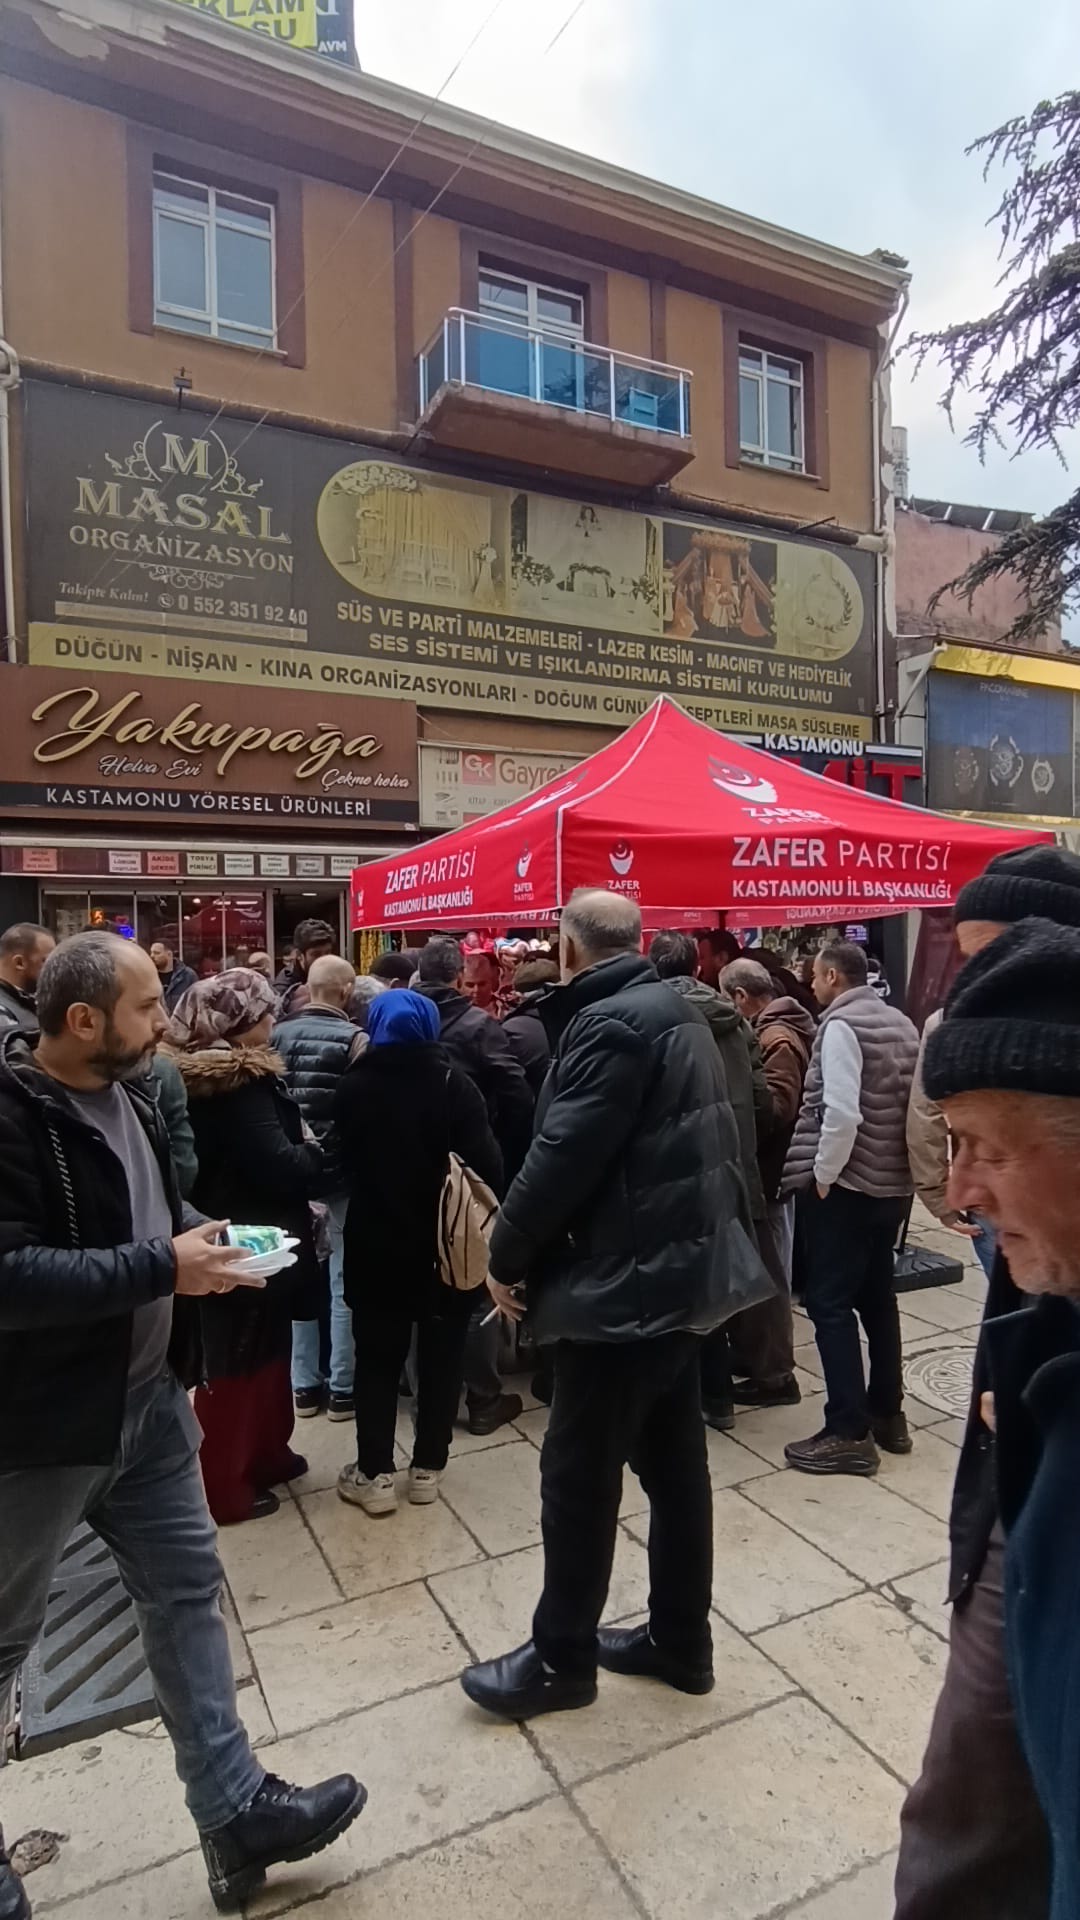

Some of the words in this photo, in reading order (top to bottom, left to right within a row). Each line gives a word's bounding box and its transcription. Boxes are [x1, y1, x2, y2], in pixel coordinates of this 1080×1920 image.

[184, 0, 305, 17] KLAM
[318, 40, 347, 53] AVM
[159, 432, 213, 480] M
[73, 476, 292, 544] MASAL
[69, 525, 294, 574] ORGANİZASYON
[59, 582, 105, 602] Takipte
[178, 595, 188, 611] 0
[194, 597, 224, 615] 552
[229, 601, 258, 619] 351
[264, 606, 284, 622] 92
[288, 608, 308, 626] 40
[337, 601, 373, 623] SÜS
[379, 607, 403, 628] VE
[408, 612, 462, 636] PARTİ
[467, 619, 582, 652] MALZEMELERİ
[598, 637, 646, 660] LAZER
[650, 644, 693, 667] KESİM
[707, 652, 763, 675] MAGNET
[768, 661, 785, 678] VE
[789, 664, 852, 688] HEDİYELİK
[369, 632, 409, 653] SES
[415, 636, 498, 665] SİSTEMİ
[506, 651, 531, 668] VE
[538, 654, 671, 685] IŞIKLANDIRMA
[676, 669, 741, 693] SİSTEMİ
[747, 680, 833, 704] KURULUMU
[55, 635, 143, 663] DÜĞÜN
[167, 646, 238, 673] NİŞAN
[260, 658, 314, 680] KINA
[320, 664, 517, 702] ORGANİZASYONLARI
[534, 689, 598, 710] DOĞUM
[603, 695, 648, 715] GÜNÜ
[683, 705, 753, 727] SEPTLERİ
[757, 713, 798, 732] MASA
[801, 716, 860, 738] SÜSLEME
[31, 686, 384, 779] Yakupağa
[764, 732, 864, 757] KASTAMONU
[98, 754, 160, 777] Helva
[164, 758, 203, 778] Evi
[321, 768, 372, 792] Çekme
[464, 753, 494, 779] GK
[46, 787, 181, 809] KASTAMONU
[188, 791, 274, 812] YÖRESEL
[280, 795, 371, 816] ÜRÜNLERİ
[732, 836, 828, 867] ZAFER
[838, 840, 952, 871] PARTİSİ
[385, 864, 419, 894] ZAFER
[420, 845, 477, 885] PARTİSİ
[607, 879, 640, 890] ZAFER
[384, 901, 421, 917] KASTAMONU
[421, 893, 428, 911] İL
[428, 885, 474, 914] BAŞKANLIĞI
[513, 882, 533, 893] ZAFER
[732, 879, 843, 898] KASTAMONU
[847, 876, 861, 897] İL
[863, 879, 952, 903] BAŞKANLIĞI
